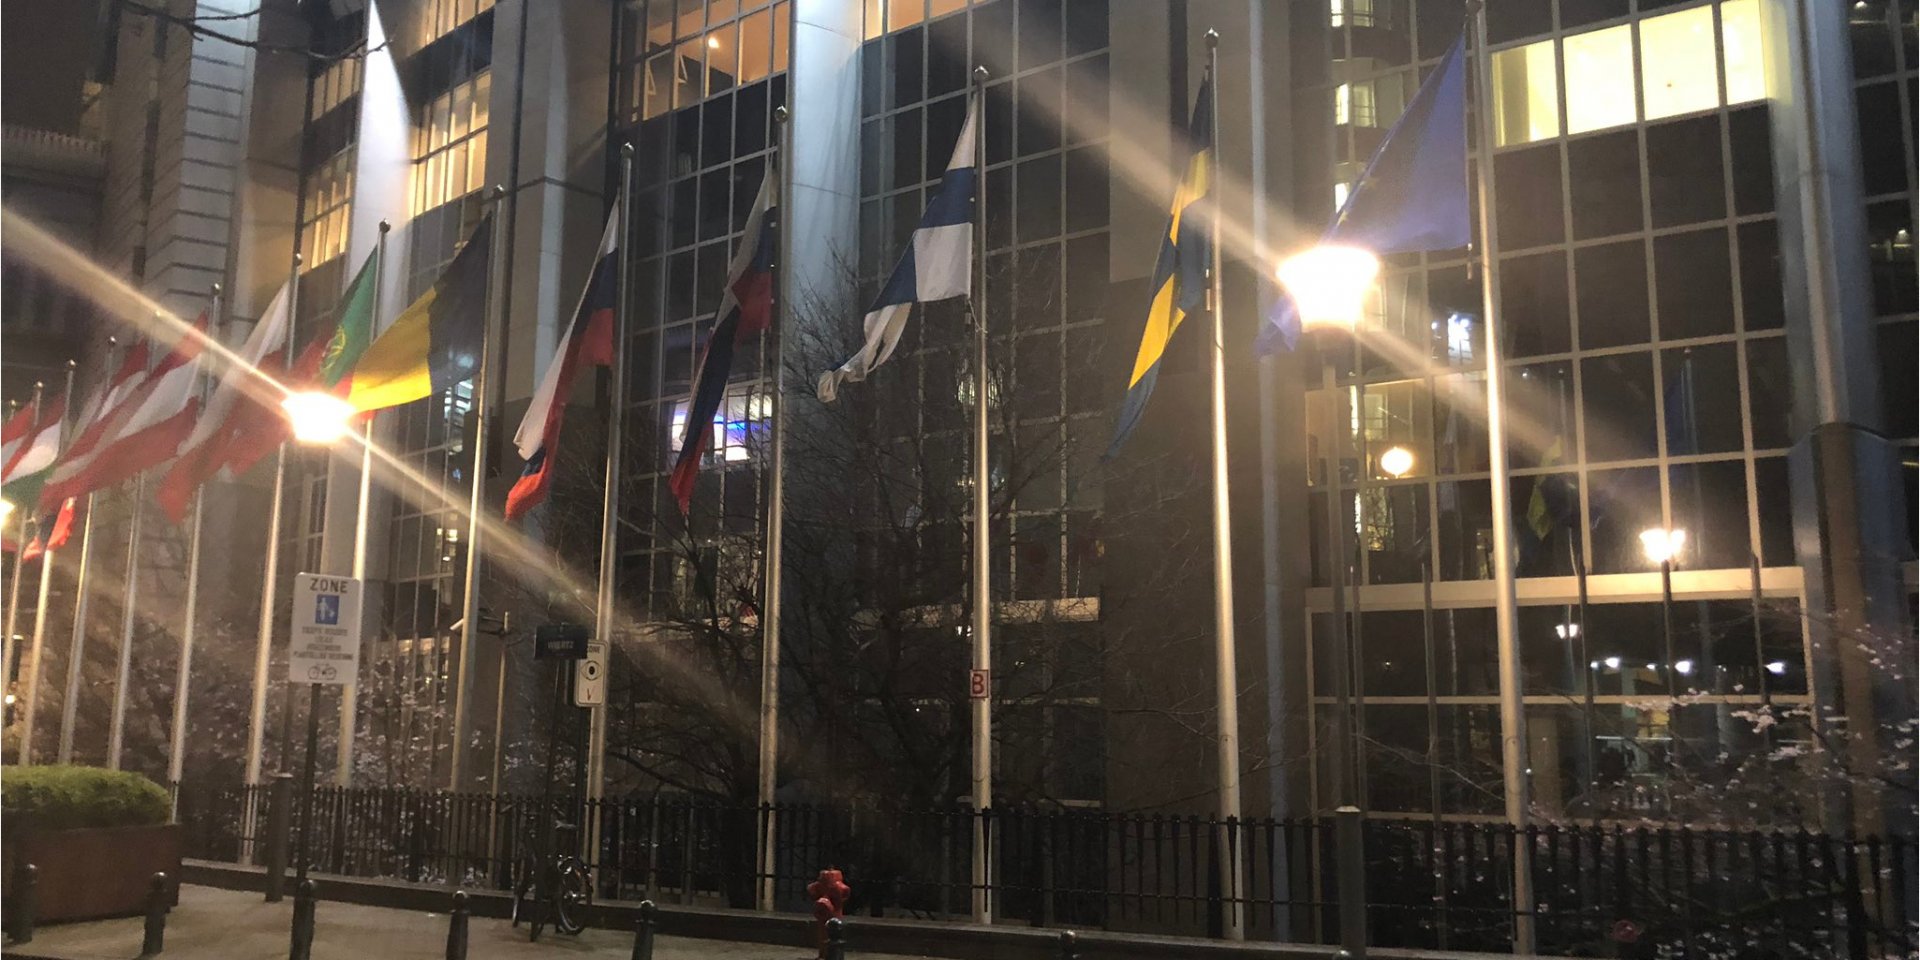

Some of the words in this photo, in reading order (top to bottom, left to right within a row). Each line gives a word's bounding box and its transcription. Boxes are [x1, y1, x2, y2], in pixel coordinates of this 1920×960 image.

[310, 577, 348, 593] ZONE
[587, 645, 601, 654] ONE
[972, 673, 984, 694] B
